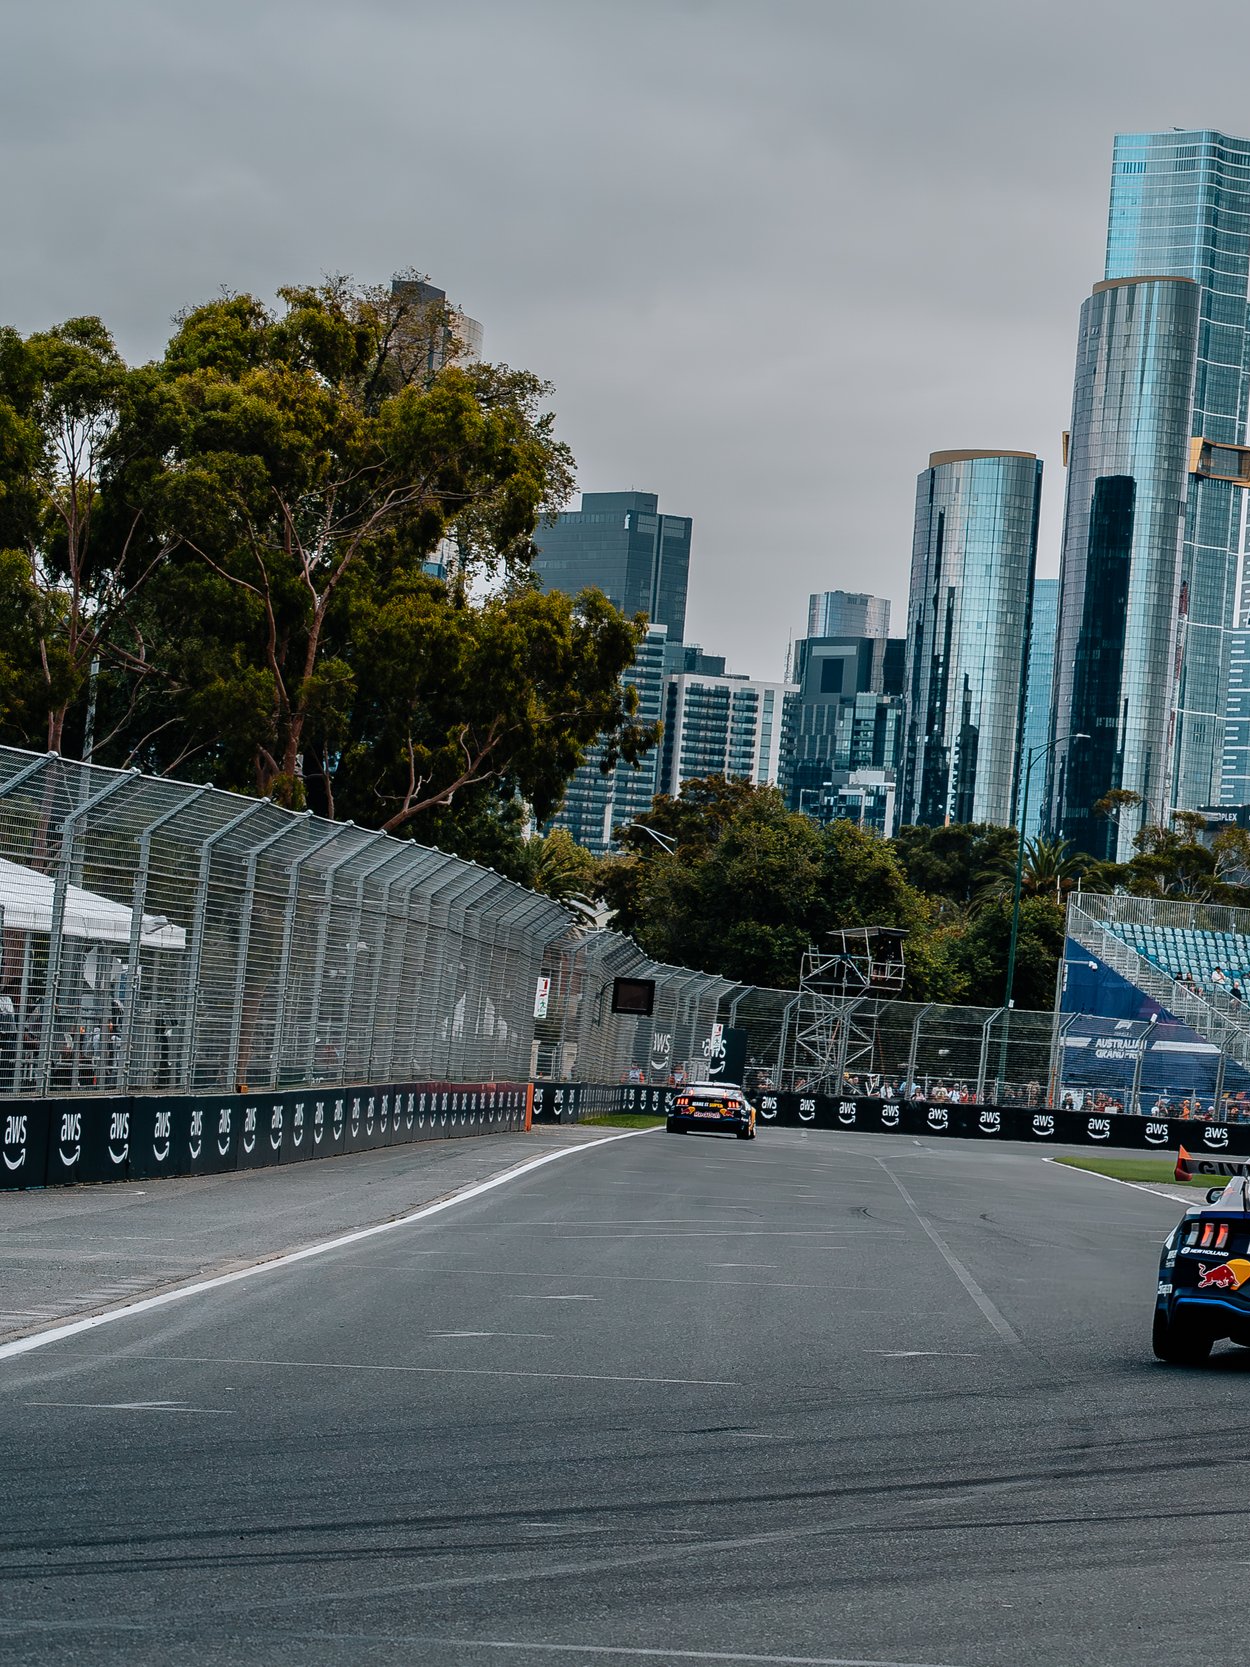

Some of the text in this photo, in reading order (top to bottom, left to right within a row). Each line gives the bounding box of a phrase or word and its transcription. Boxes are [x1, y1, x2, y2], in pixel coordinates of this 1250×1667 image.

[1095, 1049, 1142, 1061] GRAND PRI
[761, 1096, 777, 1109] aws
[800, 1098, 816, 1112] aws
[839, 1102, 856, 1115] aws
[882, 1104, 900, 1117] aws
[928, 1108, 948, 1121] aws
[191, 1111, 203, 1136] aws
[219, 1109, 231, 1133] aws
[245, 1108, 257, 1132] aws
[272, 1106, 283, 1129] aws
[980, 1112, 1000, 1124] aws
[1033, 1115, 1054, 1127] aws
[1088, 1118, 1110, 1130] aws
[5, 1116, 27, 1144] aws
[61, 1113, 81, 1141] aws
[110, 1113, 129, 1139] aws
[155, 1112, 171, 1137] aws
[1146, 1123, 1169, 1135] aws
[1204, 1127, 1228, 1139] aws
[1201, 1249, 1229, 1257] HOLLAND
